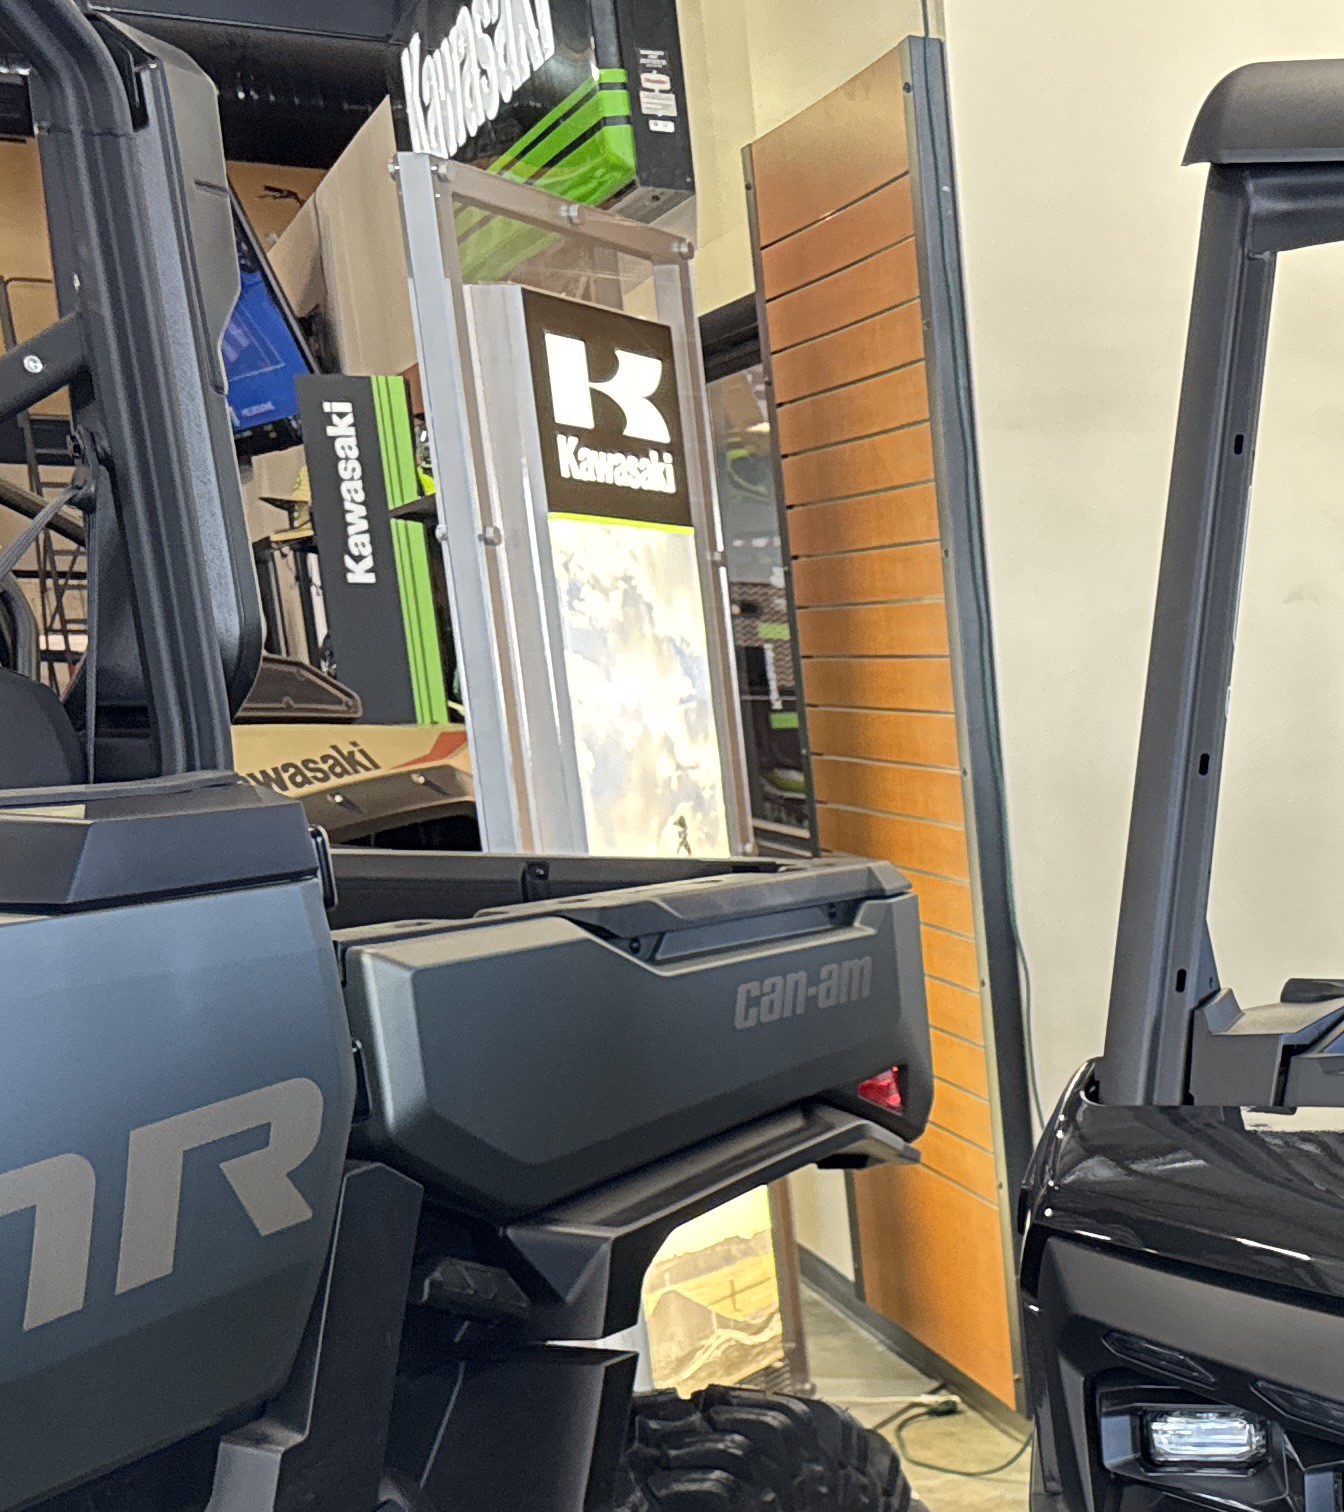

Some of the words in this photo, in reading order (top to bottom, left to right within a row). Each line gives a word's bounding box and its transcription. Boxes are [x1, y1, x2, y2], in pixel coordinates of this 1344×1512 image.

[322, 401, 376, 584] Kawasaki
[556, 433, 677, 494] Kawasaki
[247, 741, 381, 792] wasaki
[734, 956, 873, 1030] can-am
